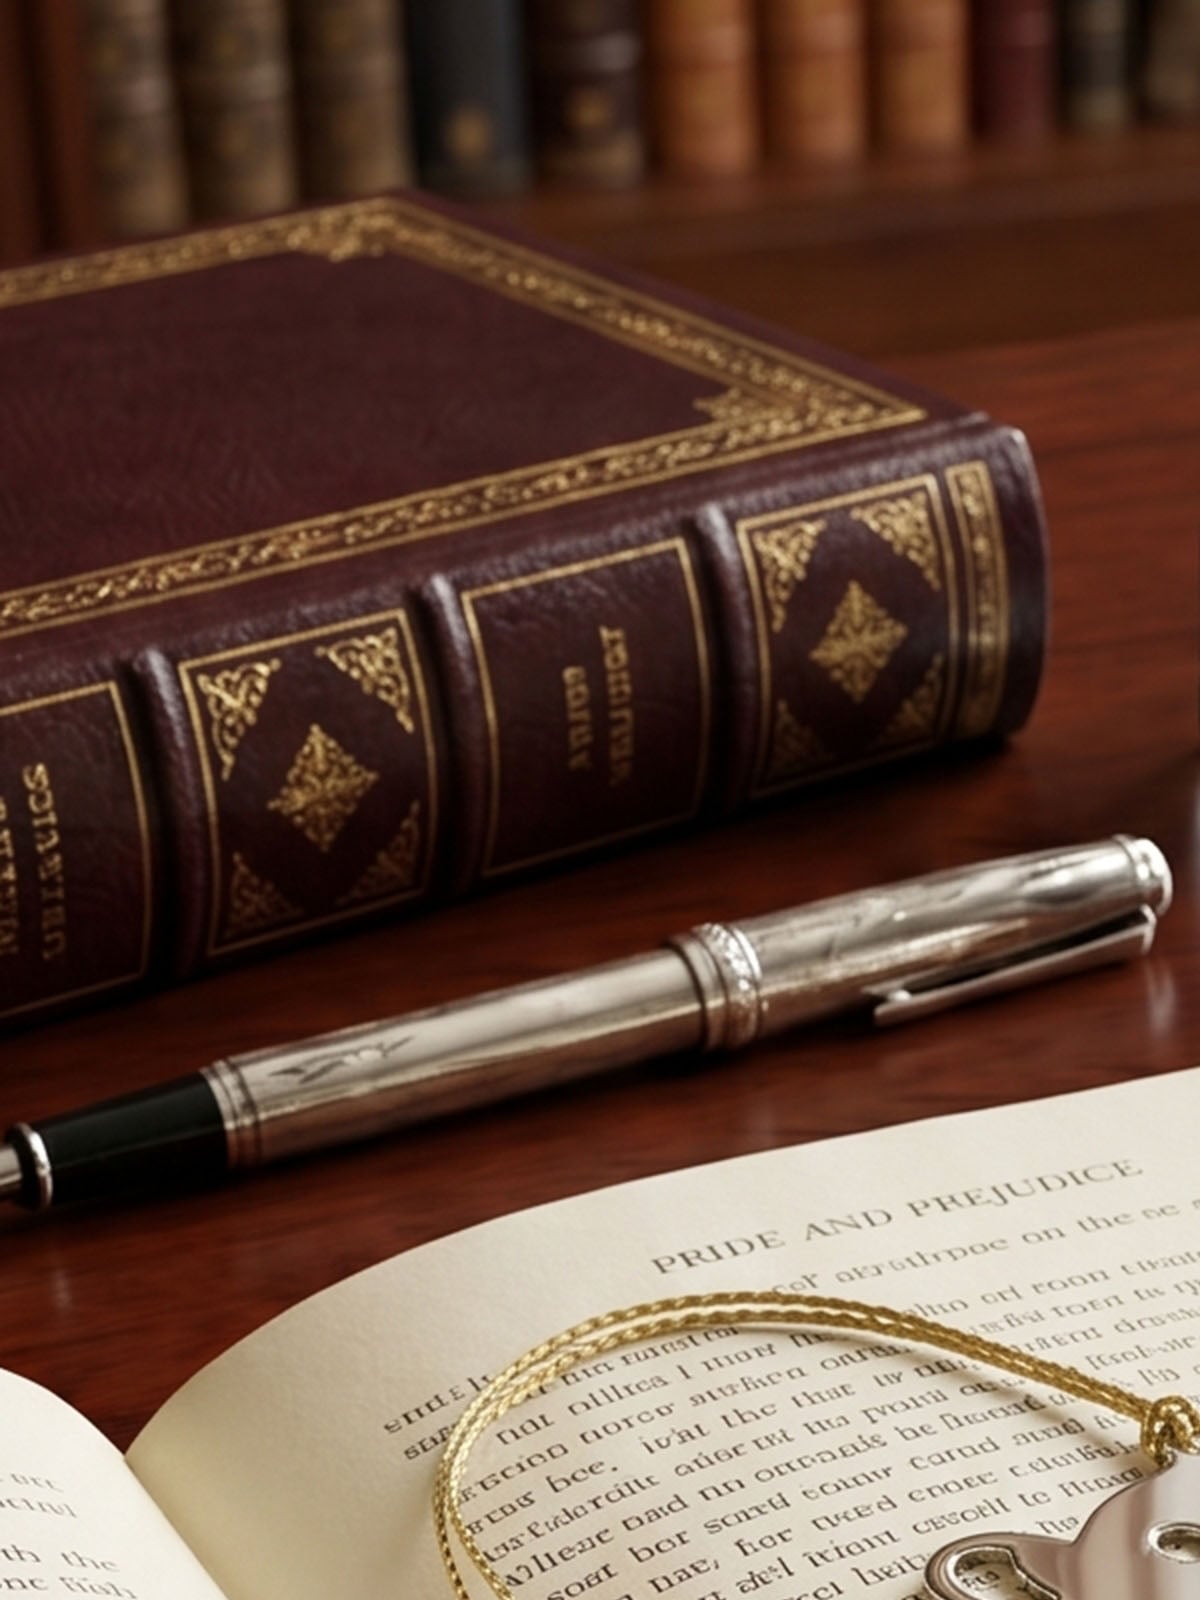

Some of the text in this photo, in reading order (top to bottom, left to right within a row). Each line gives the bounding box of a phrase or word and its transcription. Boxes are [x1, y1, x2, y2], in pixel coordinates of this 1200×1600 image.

[650, 1159, 1144, 1275] PRIDE AND PREJUDICE
